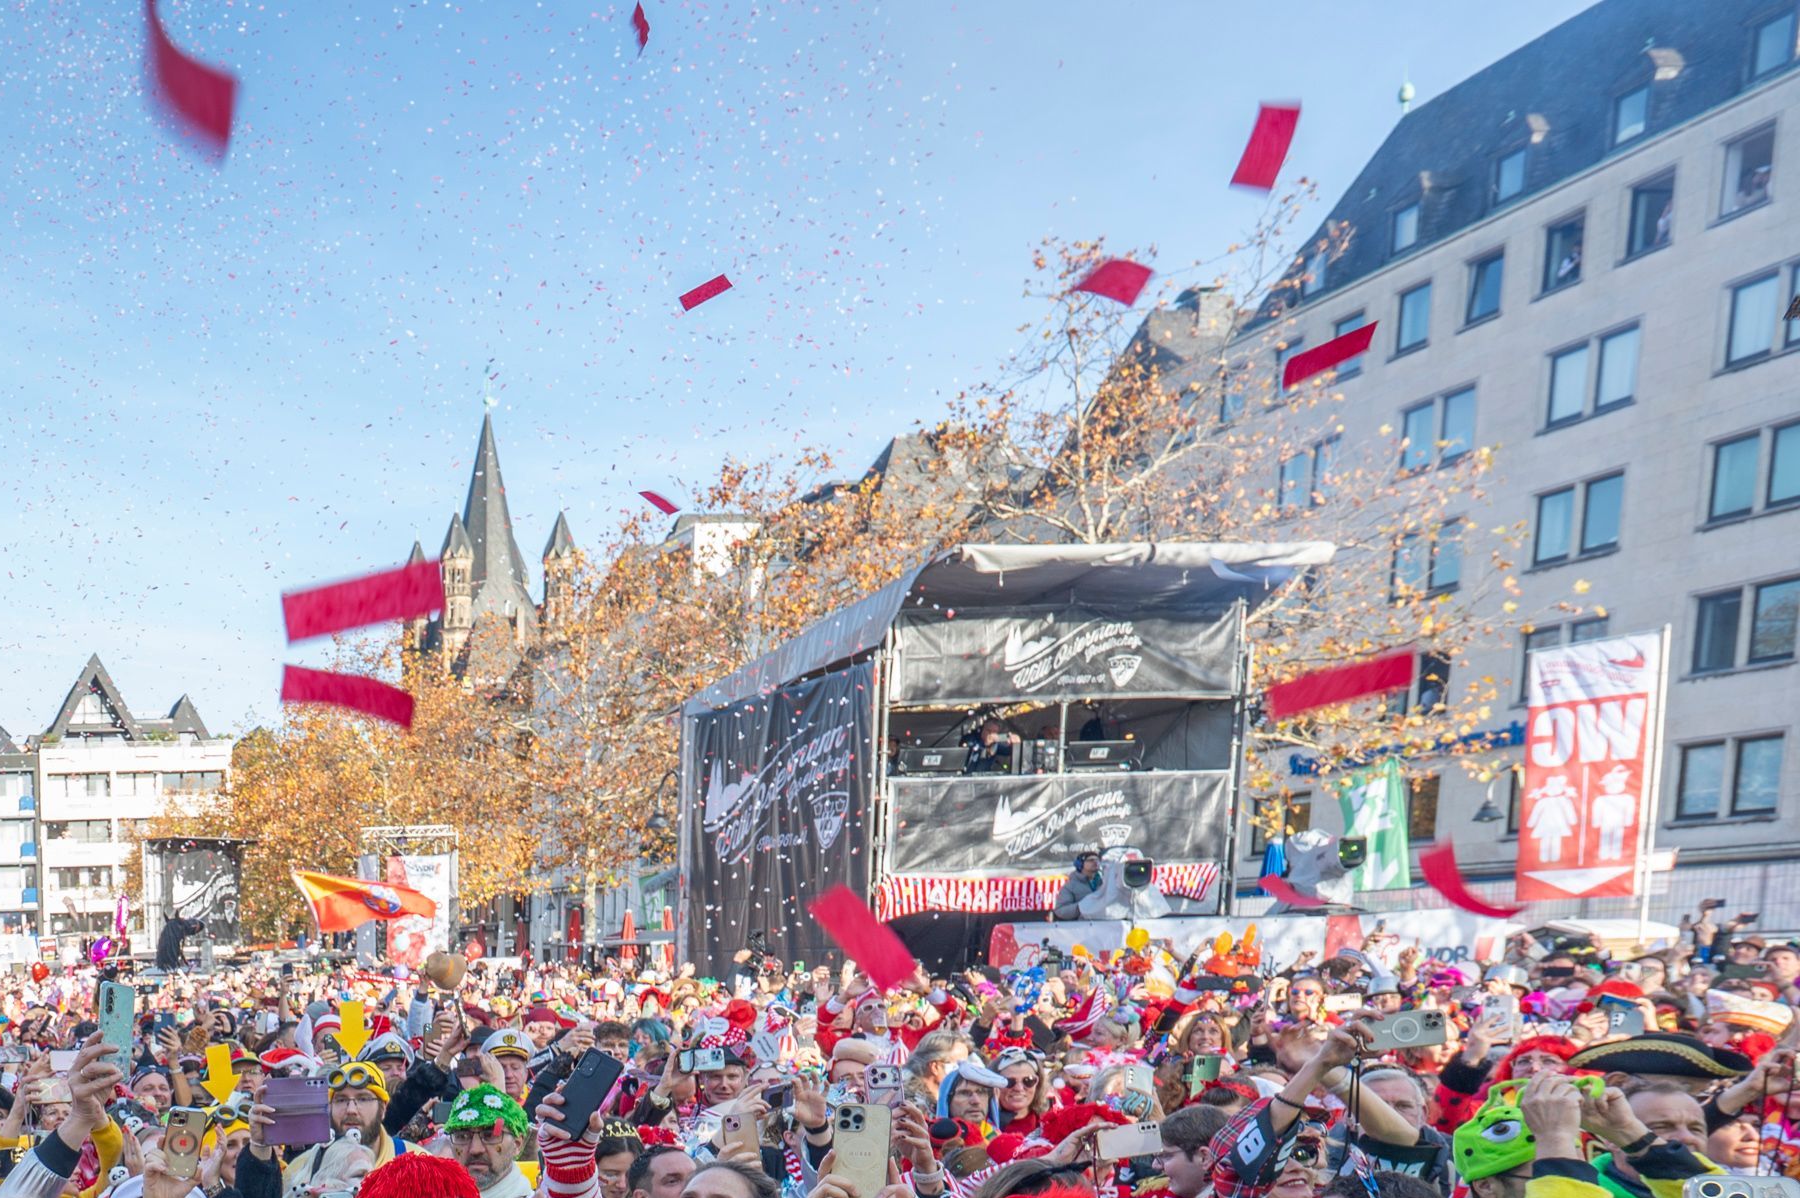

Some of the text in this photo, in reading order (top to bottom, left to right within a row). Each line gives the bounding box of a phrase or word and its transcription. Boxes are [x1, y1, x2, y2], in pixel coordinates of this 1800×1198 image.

[1054, 622, 1134, 670] Ostermann
[1005, 790, 1125, 857] Willi Ostermann
[1426, 944, 1470, 963] WDR
